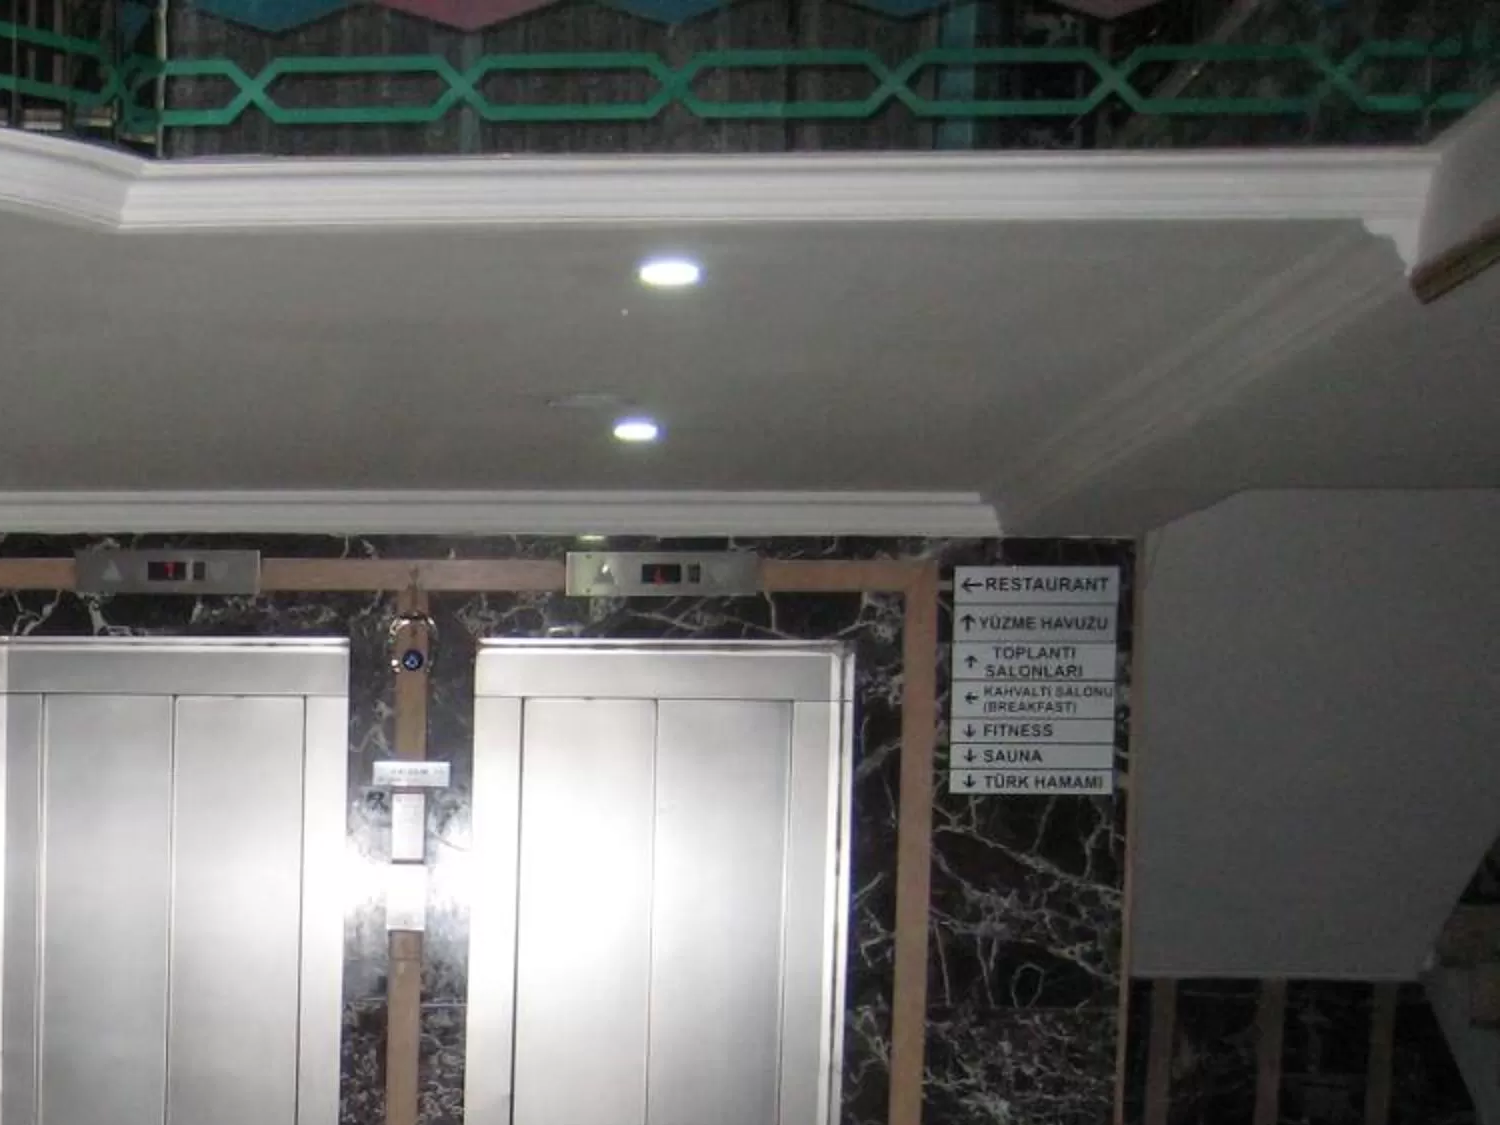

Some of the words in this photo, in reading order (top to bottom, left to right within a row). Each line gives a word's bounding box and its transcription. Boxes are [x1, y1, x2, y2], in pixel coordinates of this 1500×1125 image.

[985, 577, 1109, 592] RESTAURANT
[979, 615, 1037, 630] YÜZME
[1041, 616, 1109, 630] HAVUZU
[993, 646, 1077, 660] TOPLANTI
[984, 664, 1083, 678] SALONLARI
[1055, 685, 1113, 698] SALONU
[983, 701, 1077, 714] (BREAKFAST)
[983, 723, 1054, 737] FITNESS
[983, 749, 1043, 763] SAUNA
[984, 774, 1030, 788] TÜRK
[1034, 775, 1103, 789] HAMAMI
